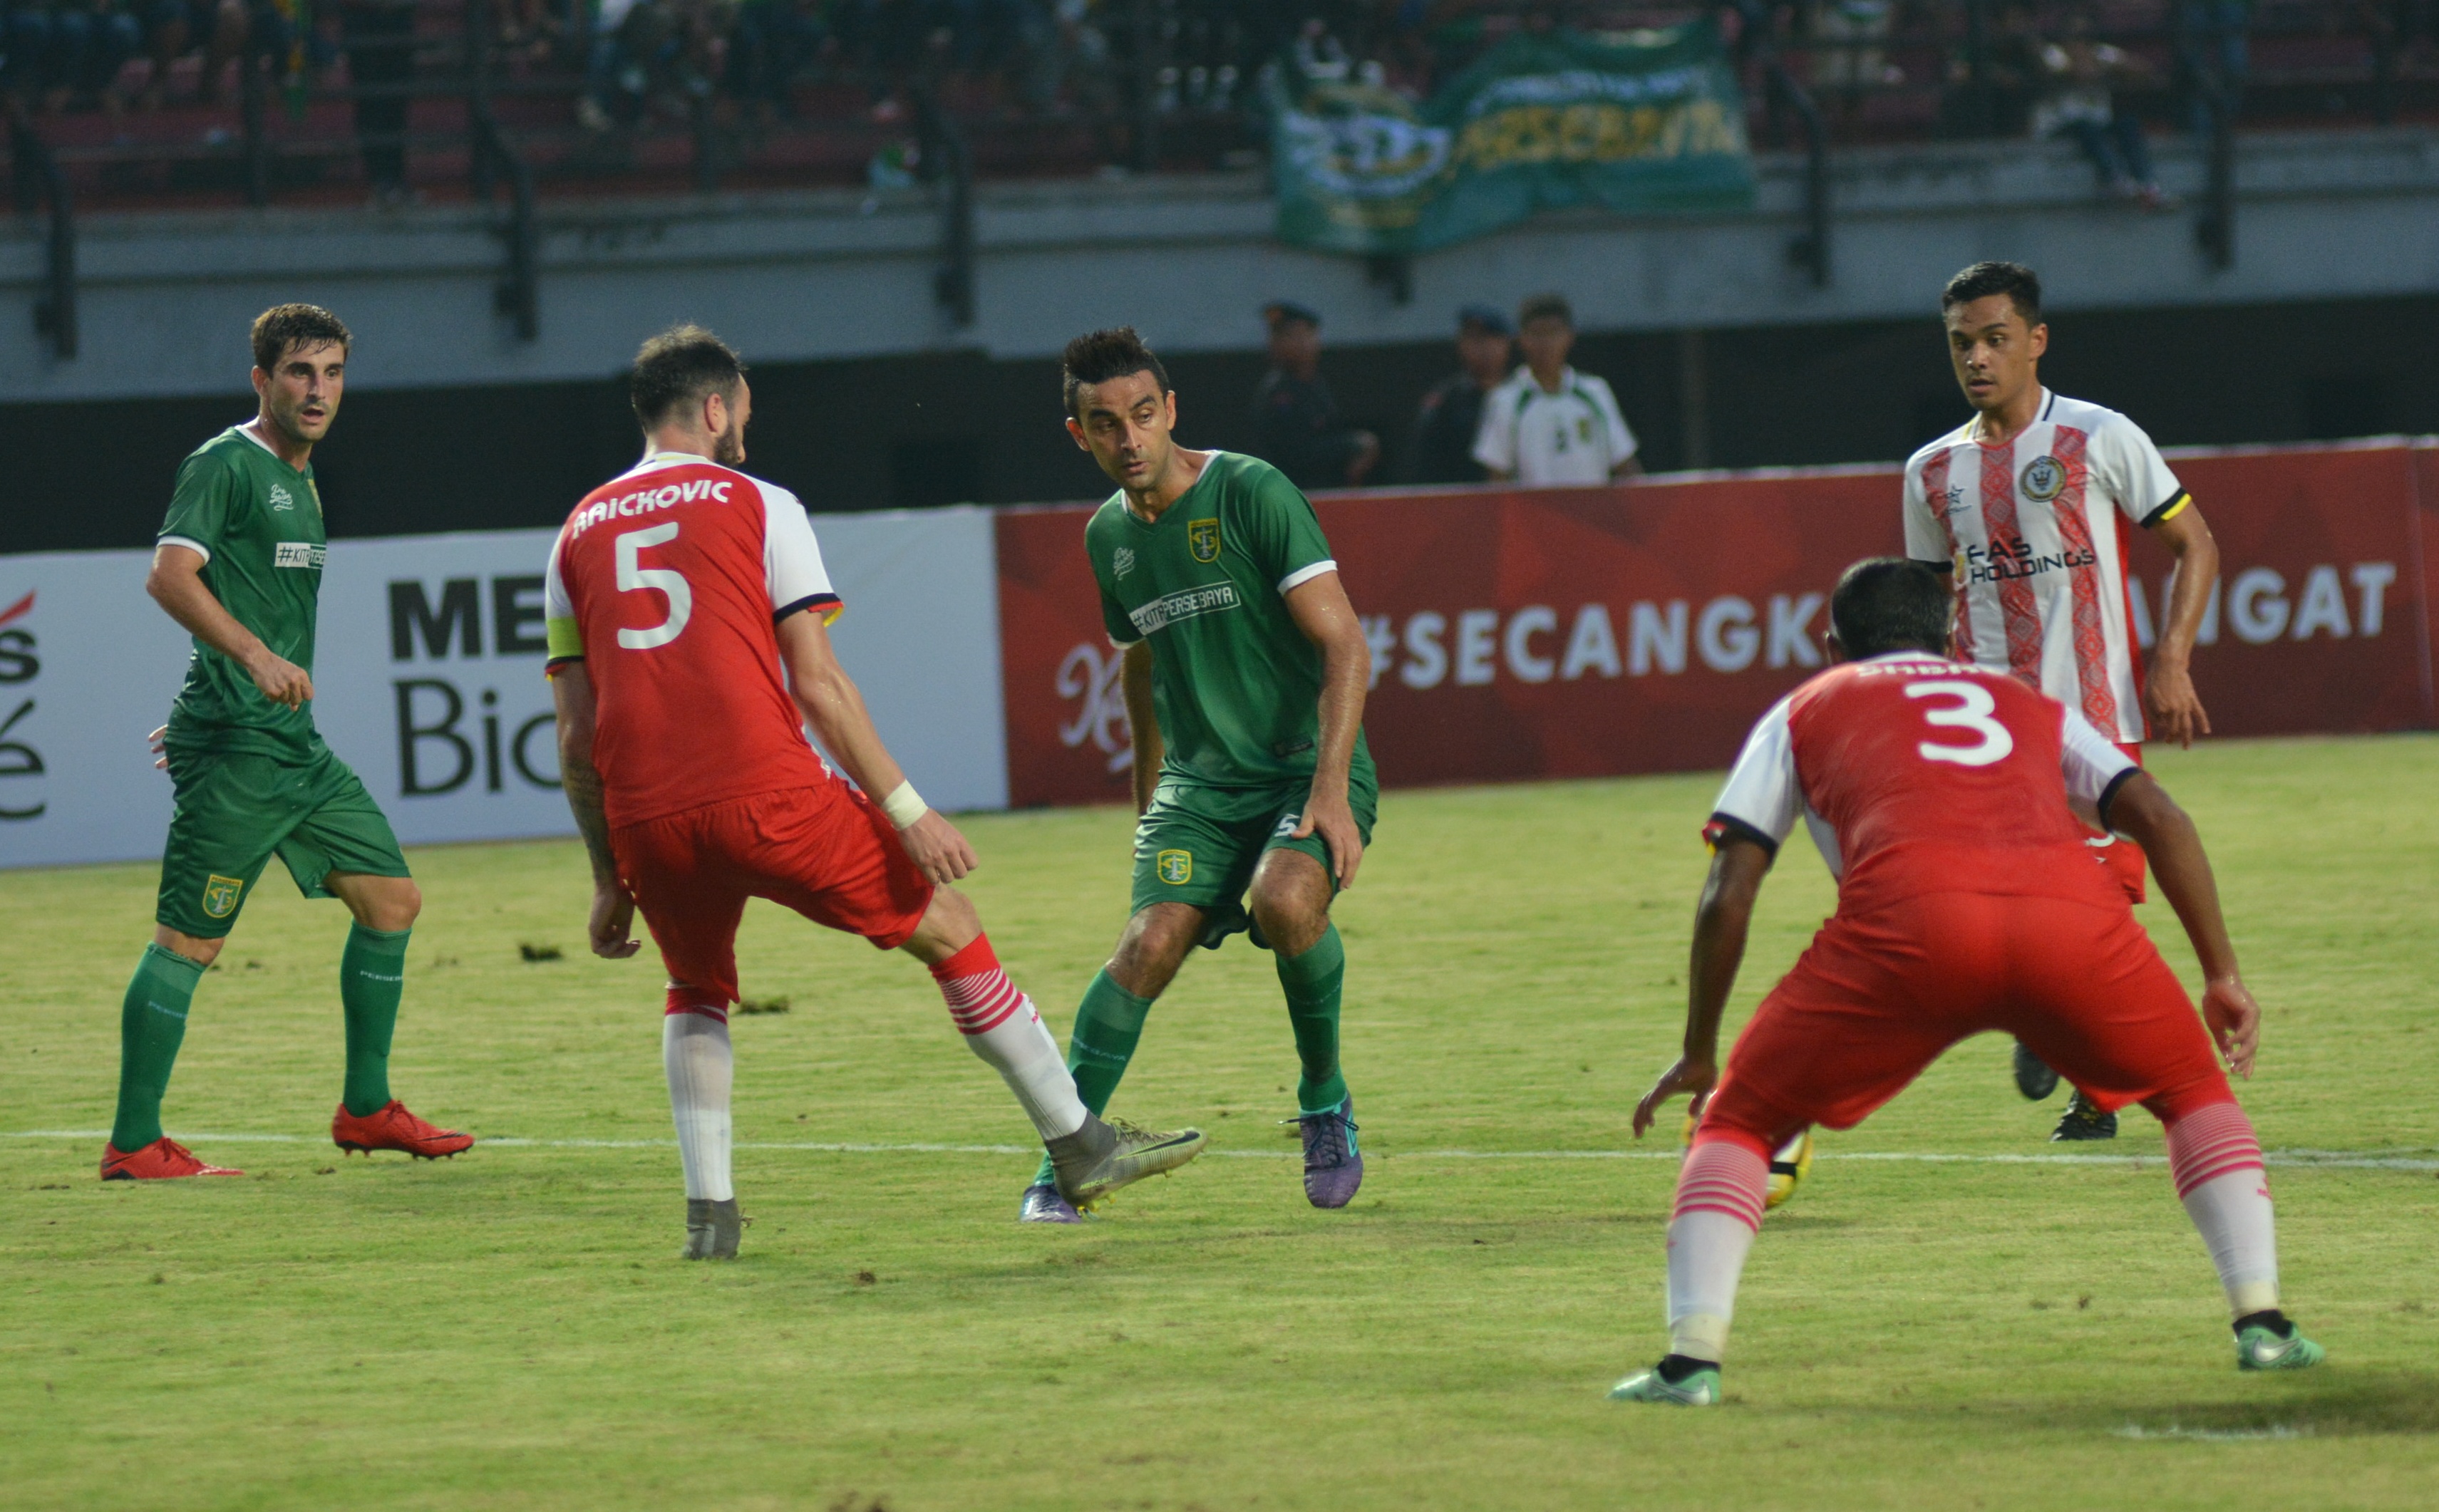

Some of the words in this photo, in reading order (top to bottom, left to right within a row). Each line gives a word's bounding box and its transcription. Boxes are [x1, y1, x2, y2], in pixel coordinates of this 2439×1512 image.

[1967, 537, 2032, 565] FAS
[1971, 549, 2095, 584] HOLDINGS
[615, 521, 692, 650] 5
[1904, 680, 2013, 767] 3
